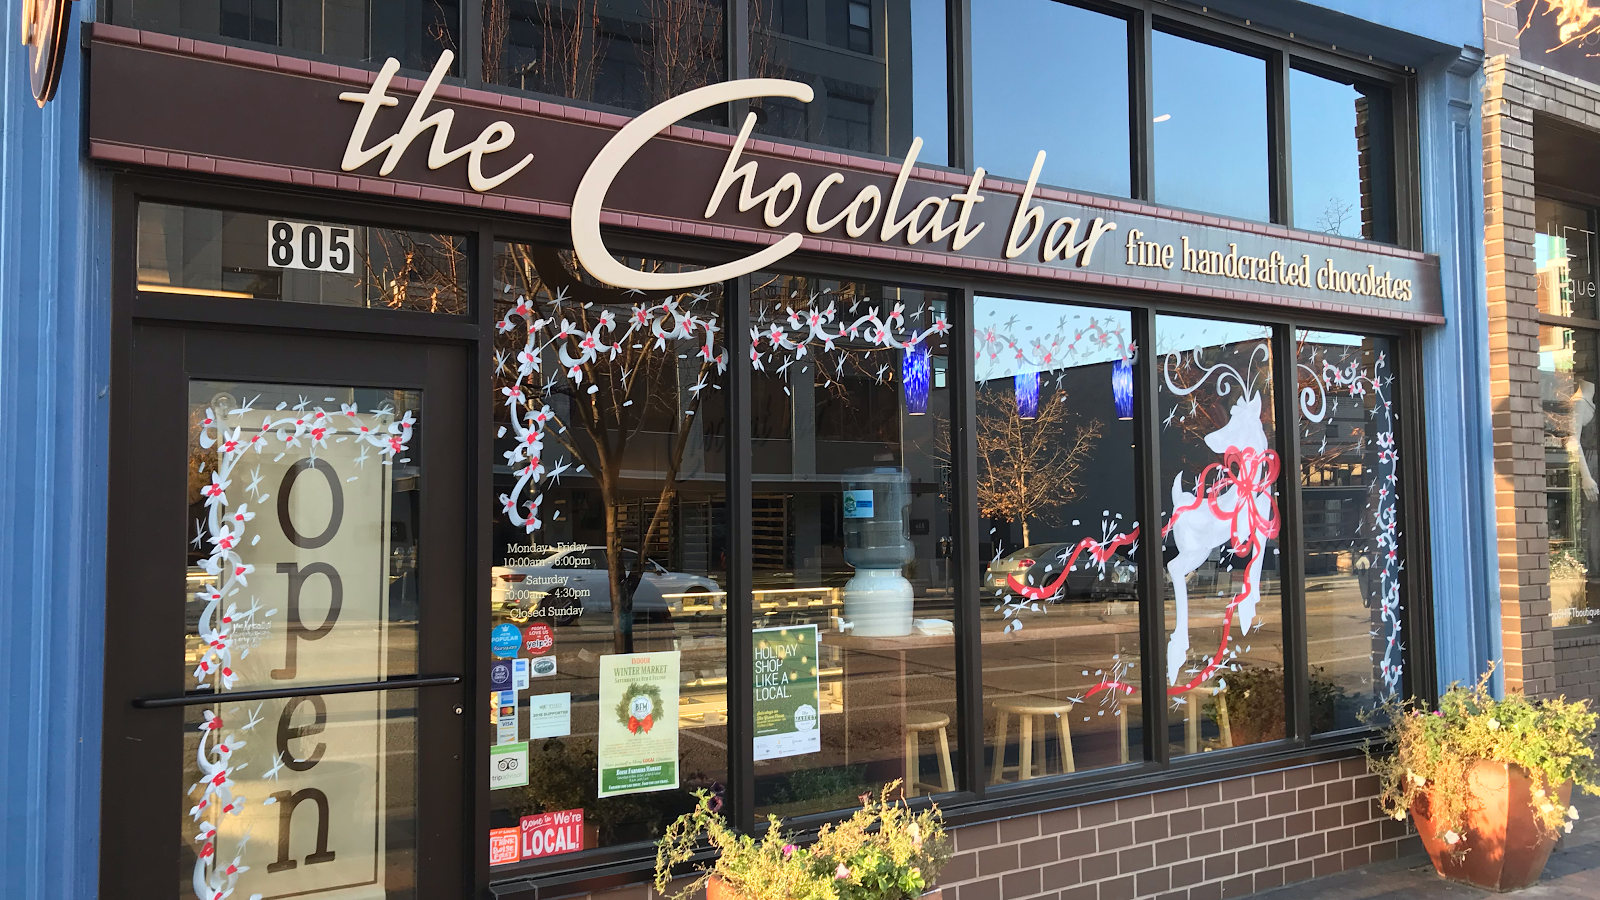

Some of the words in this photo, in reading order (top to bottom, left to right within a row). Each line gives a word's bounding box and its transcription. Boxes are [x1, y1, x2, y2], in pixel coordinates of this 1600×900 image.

[338, 49, 534, 192] the
[569, 78, 986, 290] Chocolat
[1005, 149, 1117, 267] bar
[270, 221, 351, 271] 805
[1125, 228, 1175, 270] fine
[1181, 235, 1312, 289] handcrafted
[1316, 258, 1413, 302] chocolates
[506, 542, 549, 555] Monday
[556, 541, 588, 554] Friday
[503, 557, 546, 568] 10:00am
[554, 556, 591, 568] 6:00pm
[525, 574, 569, 586] Saturday
[554, 588, 591, 599] 4:30pm
[509, 606, 546, 618] Closed
[547, 605, 585, 617] Sunday
[526, 639, 545, 650] yelp
[754, 643, 798, 660] HOLIDAY
[613, 666, 640, 676] WINTER
[641, 664, 668, 675] MARKET
[754, 659, 784, 674] SHOP
[755, 672, 779, 688] LIKE
[781, 672, 789, 684] A
[756, 685, 792, 702] LOCAL.
[635, 702, 648, 712] BFM
[491, 771, 524, 782] tripadvisor
[521, 818, 543, 831] Come
[543, 814, 552, 822] in
[553, 811, 582, 826] We're
[492, 837, 515, 846] THINK
[522, 824, 580, 857] LOCAL!
[492, 845, 515, 855] BOISE
[493, 851, 514, 860] FIRST
